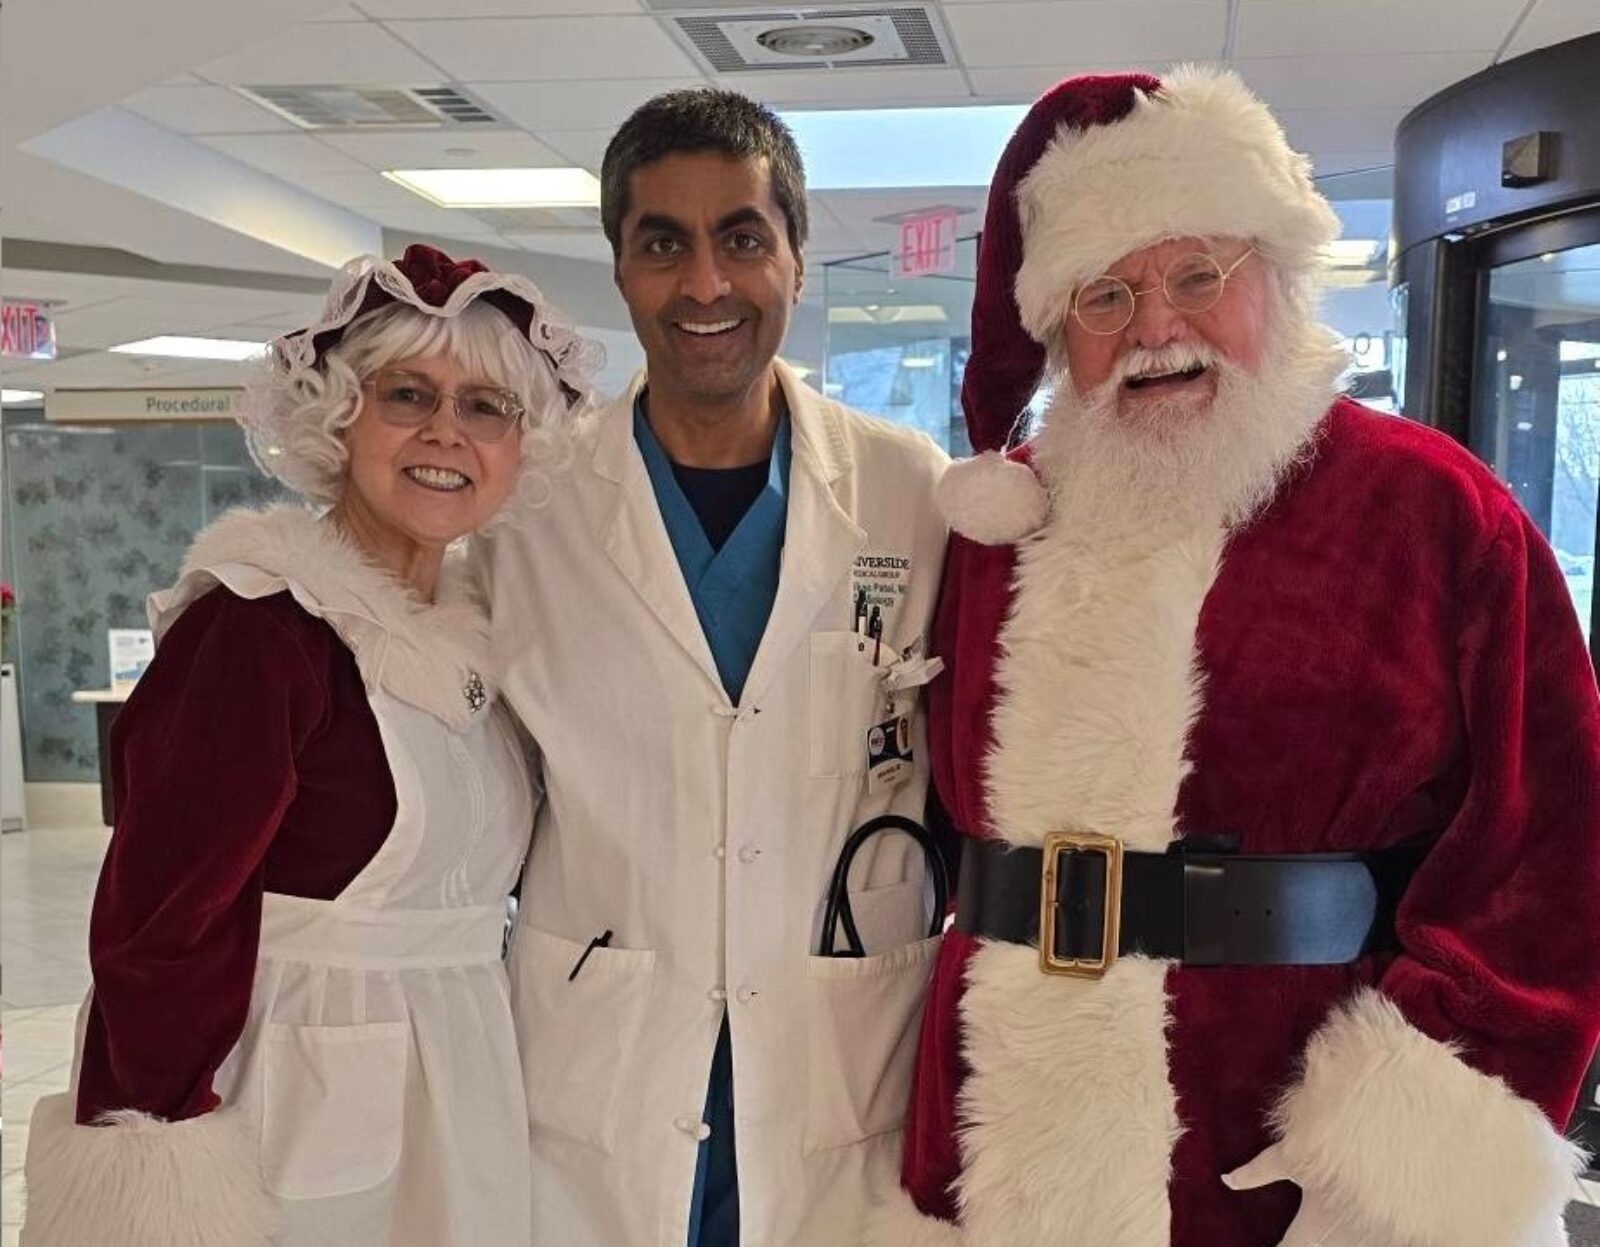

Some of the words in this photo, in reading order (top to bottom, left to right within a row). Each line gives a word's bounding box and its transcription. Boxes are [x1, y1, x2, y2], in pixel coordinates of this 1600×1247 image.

[902, 217, 943, 273] EXIT
[145, 395, 231, 412] Procedural
[853, 556, 910, 570] IVERSIDE
